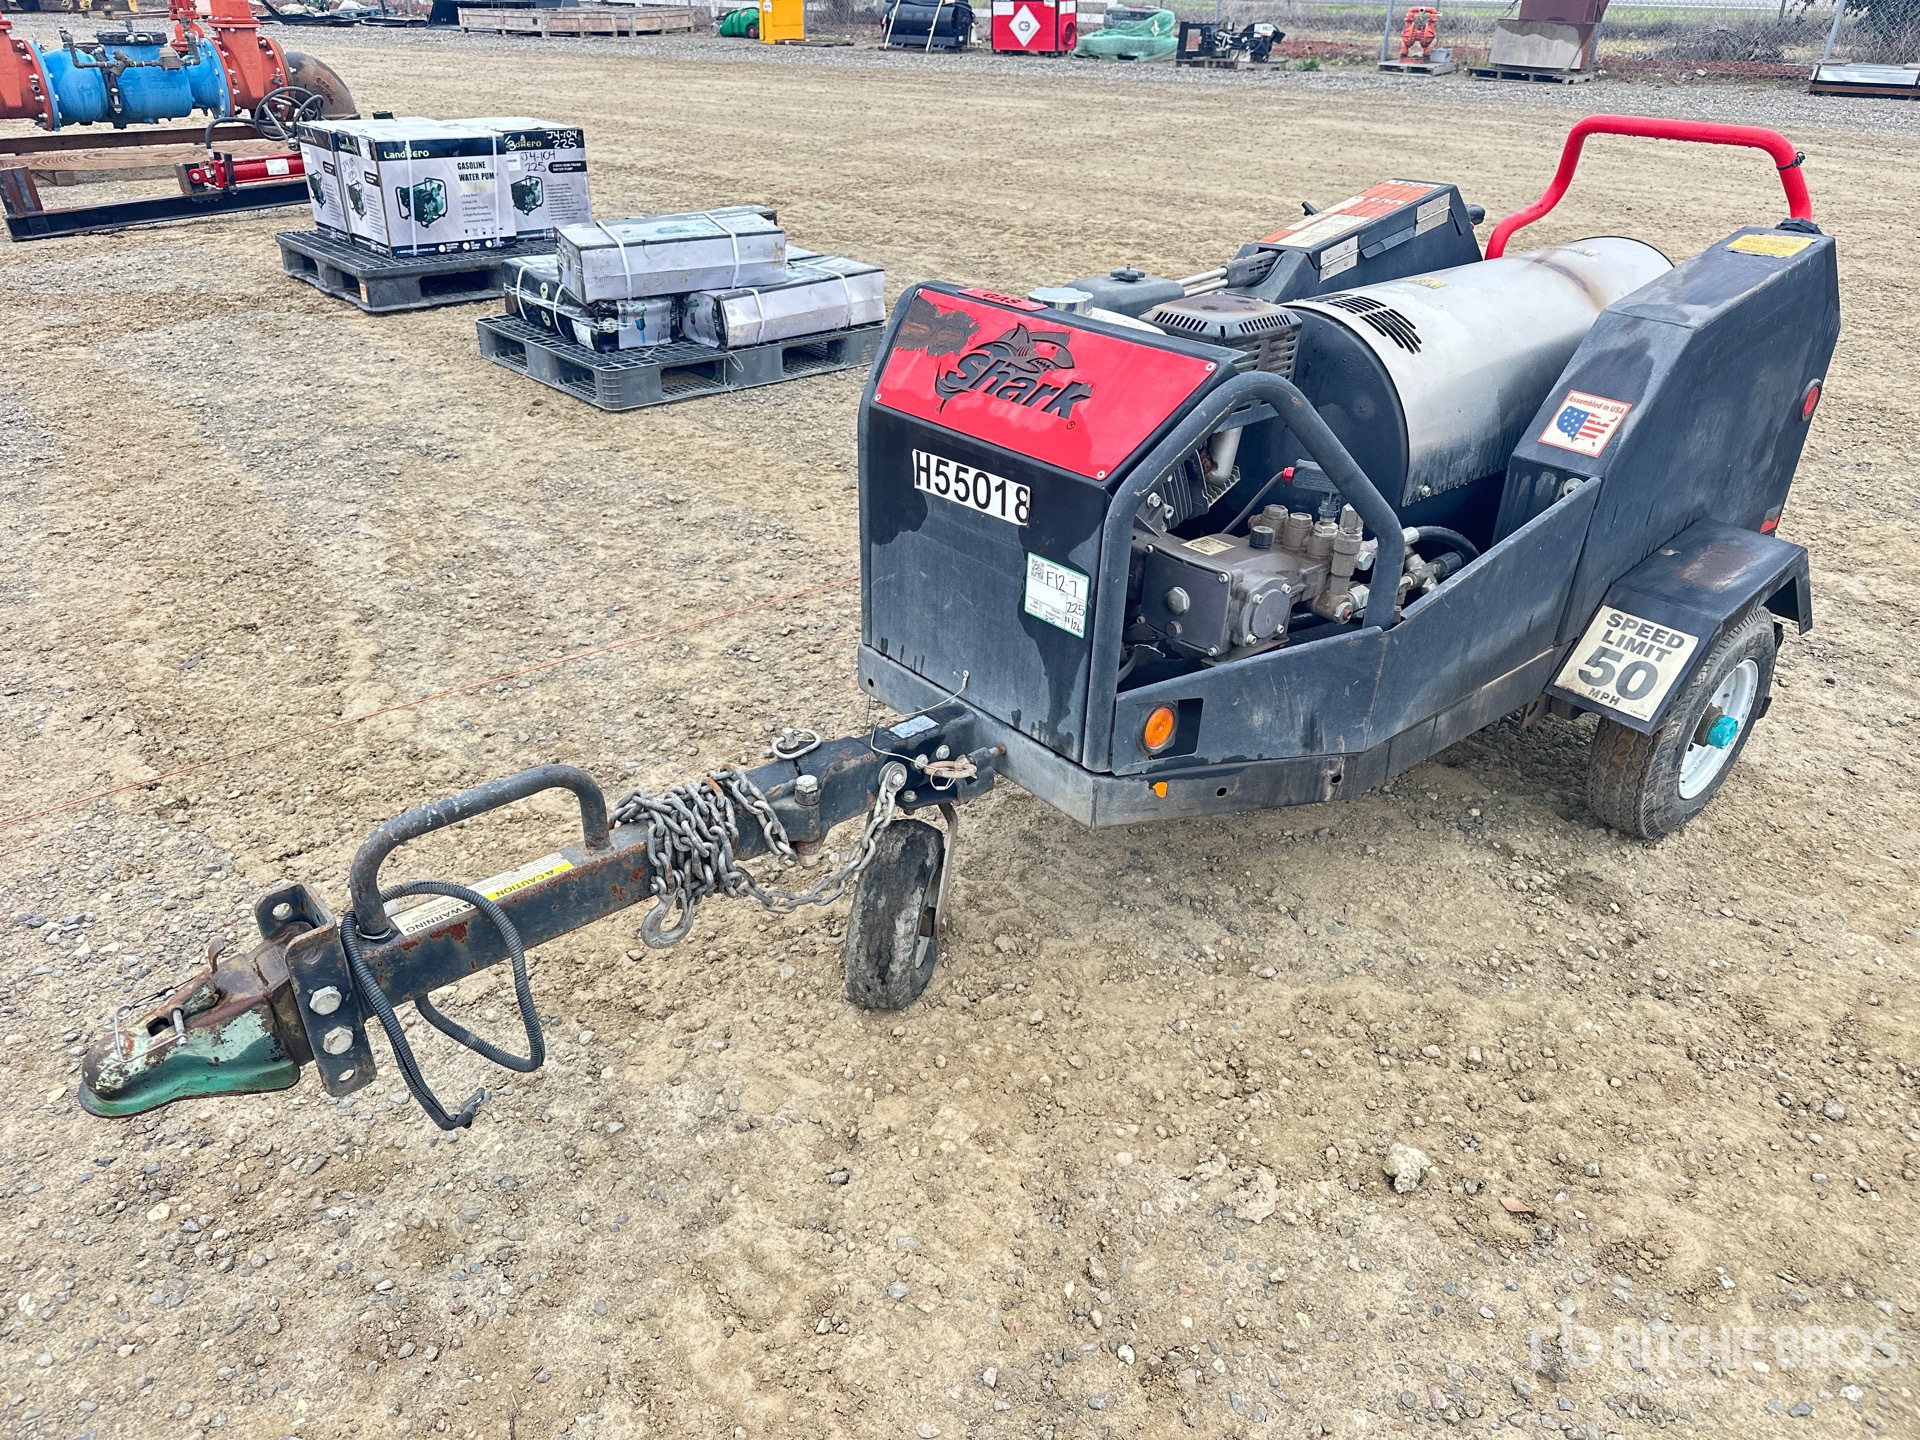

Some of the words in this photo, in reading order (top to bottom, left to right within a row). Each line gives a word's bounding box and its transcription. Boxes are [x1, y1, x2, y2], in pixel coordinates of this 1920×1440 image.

[552, 138, 577, 149] 225
[457, 161, 486, 170] GASOLINE
[524, 162, 547, 172] 225
[458, 172, 480, 182] WATER
[481, 172, 499, 180] PUM
[982, 293, 1023, 305] GAS
[944, 352, 1094, 419] Shark
[1569, 395, 1601, 409] Assembled
[1602, 403, 1610, 411] in
[1610, 405, 1625, 415] USA
[915, 450, 1029, 523] H55018
[1066, 601, 1085, 616] 225
[1606, 613, 1685, 649] SPEED
[1601, 629, 1673, 663] LIMIT
[1578, 645, 1659, 701] 50
[1588, 687, 1621, 706] MPH
[496, 873, 545, 897] CAUTION
[405, 907, 463, 933] WARNING
